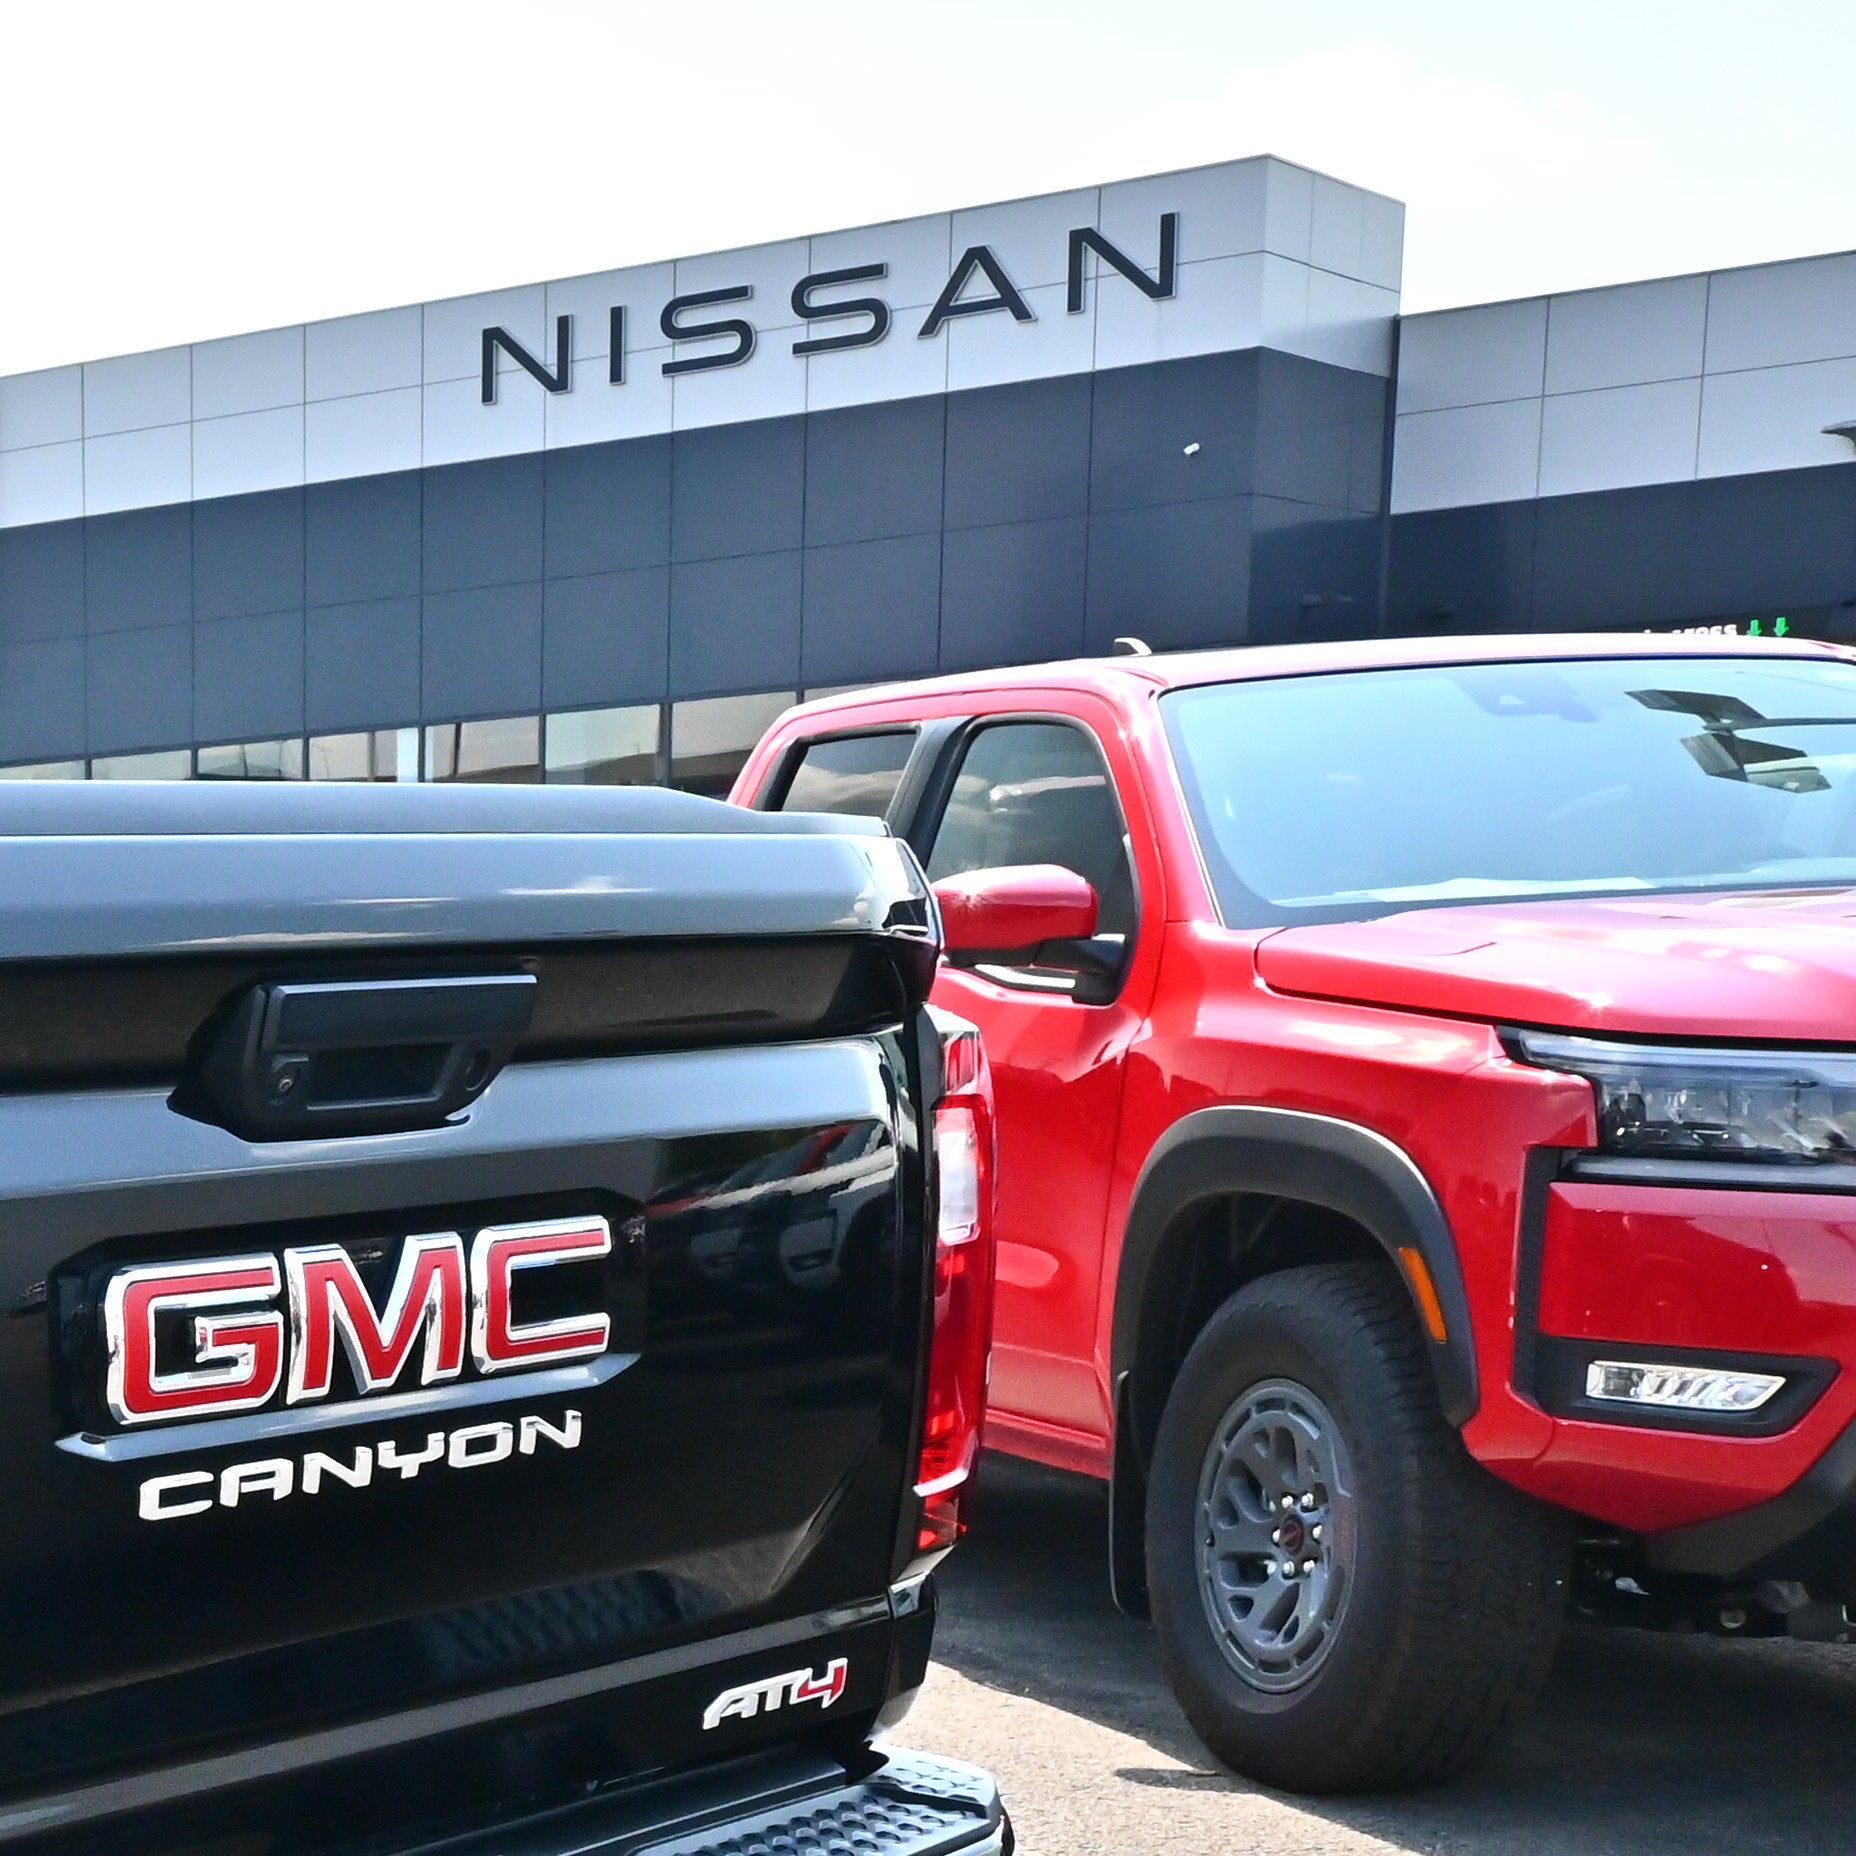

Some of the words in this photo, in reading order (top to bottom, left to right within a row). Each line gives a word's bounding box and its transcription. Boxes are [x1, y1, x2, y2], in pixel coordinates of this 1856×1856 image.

[480, 211, 1181, 406] NISSAN
[105, 1214, 612, 1426] GMC
[138, 1410, 583, 1522] CANYON
[702, 1657, 849, 1730] AT4
